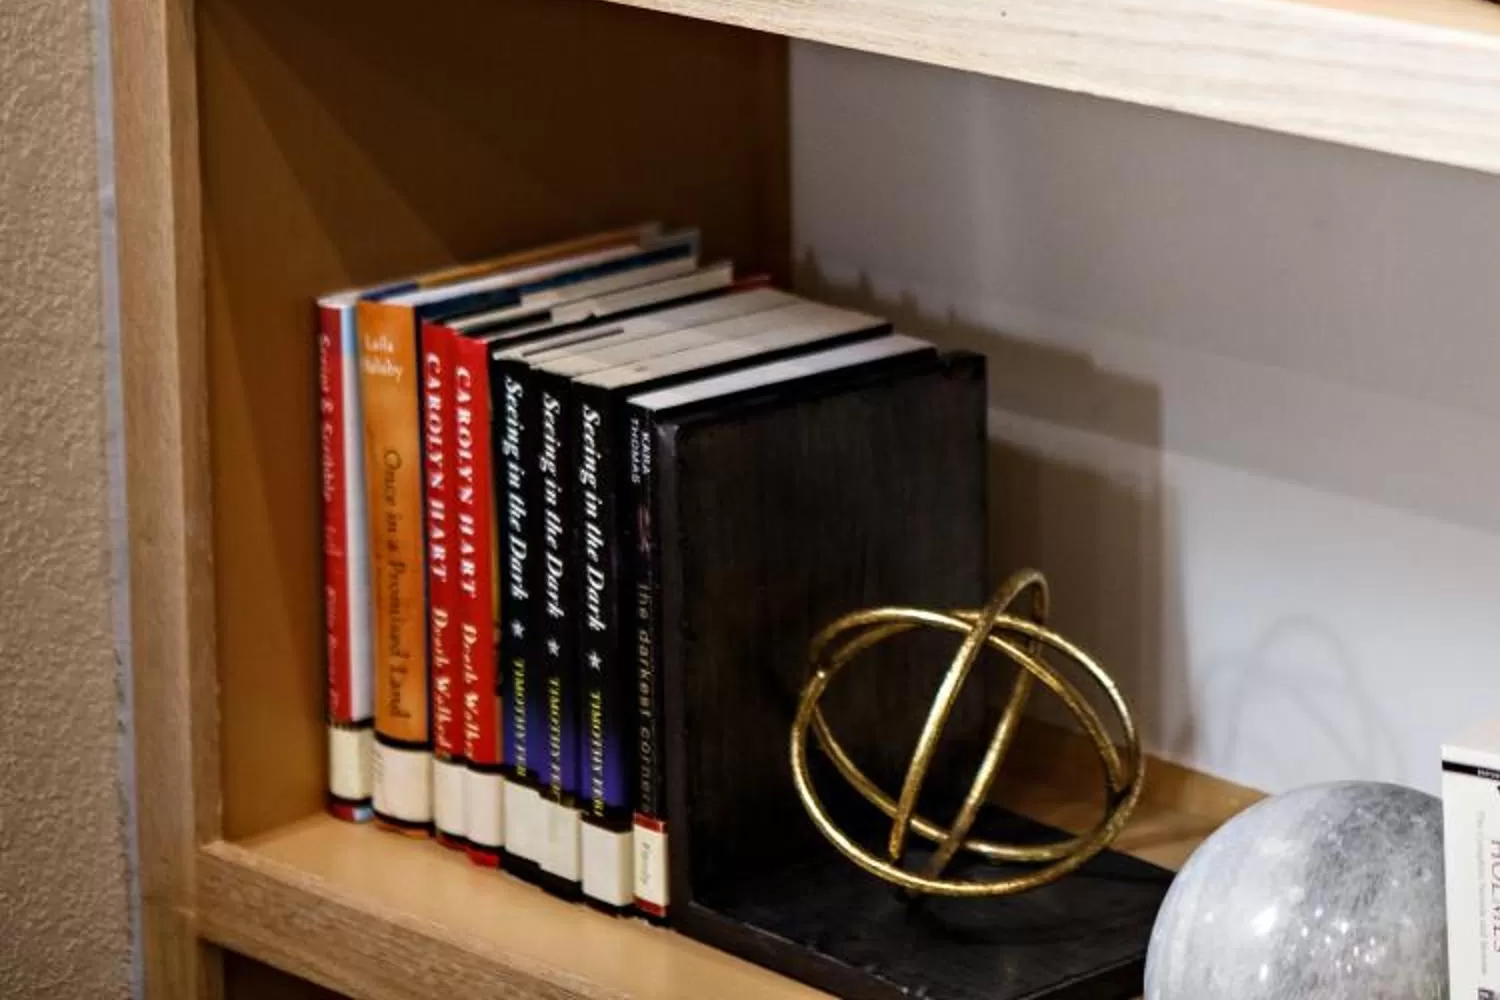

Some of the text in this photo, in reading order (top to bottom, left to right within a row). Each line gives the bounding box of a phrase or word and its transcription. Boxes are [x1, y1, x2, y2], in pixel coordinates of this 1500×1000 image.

[384, 449, 404, 506] Once
[503, 376, 528, 600] Seeing in the Dark
[630, 418, 641, 485] THOMAS
[640, 431, 651, 475] KARA
[387, 511, 404, 533] in
[388, 539, 398, 552] a
[539, 391, 564, 618] Seeing in the Dark
[579, 403, 604, 632] Seeing in the Dark
[425, 352, 453, 750] CAROLYN HART Death Walked
[455, 365, 480, 760] CAROLYN HART Death Walke
[636, 583, 654, 619] the
[389, 665, 412, 719] Land
[638, 629, 653, 717] darkest
[512, 659, 528, 778] TIMOTHY FER
[547, 678, 561, 763] TIMOTHY
[589, 691, 604, 777] TIMOTHY
